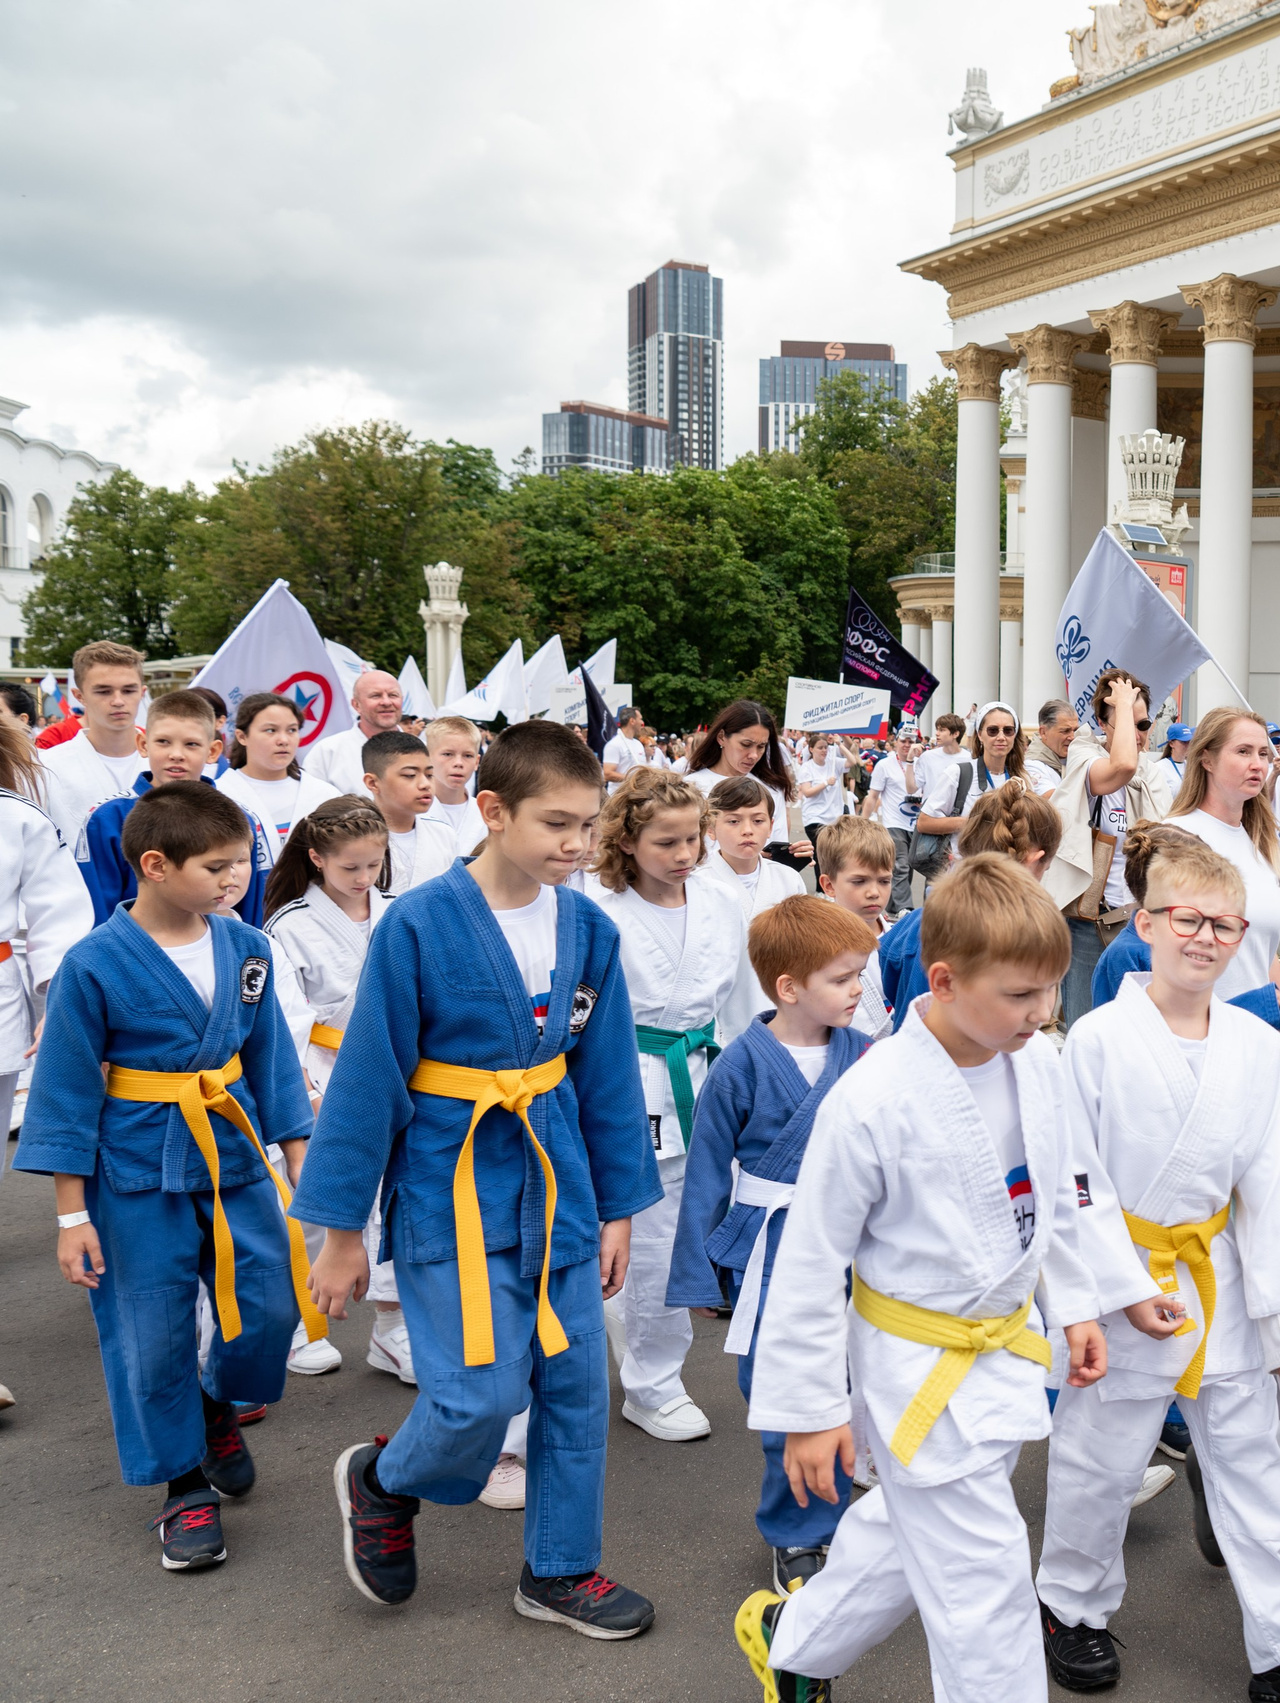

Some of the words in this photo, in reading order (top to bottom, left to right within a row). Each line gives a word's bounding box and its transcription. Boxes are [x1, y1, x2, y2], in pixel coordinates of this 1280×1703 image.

[1074, 48, 1269, 142] РОССИЙСКАЯ
[1039, 119, 1141, 173] СОВЕТСКАЯ
[1039, 118, 1196, 191] СОЦИАЛИСТИЧЕСКАЯ
[803, 699, 844, 719] ФИДЖИТАЛ
[844, 691, 865, 706] СПОРТ
[1108, 812, 1128, 825] СП
